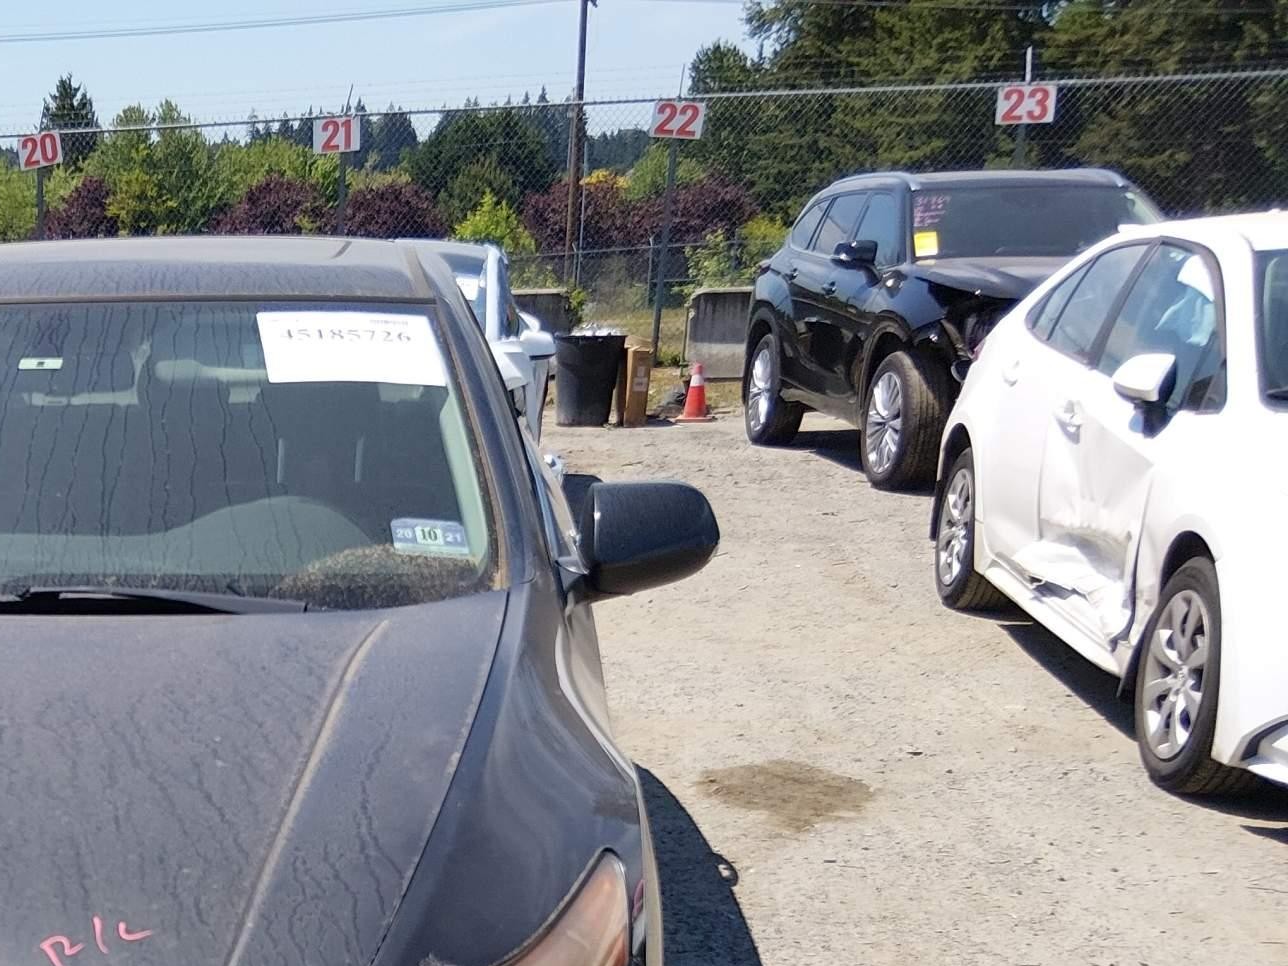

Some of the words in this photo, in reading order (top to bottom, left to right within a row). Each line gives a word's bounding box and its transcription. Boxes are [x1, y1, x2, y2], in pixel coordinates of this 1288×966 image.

[653, 102, 699, 137] 22
[1000, 86, 1049, 122] 23
[21, 133, 58, 168] 20
[321, 120, 352, 152] 21
[420, 527, 439, 542] 10
[444, 532, 463, 543] 21
